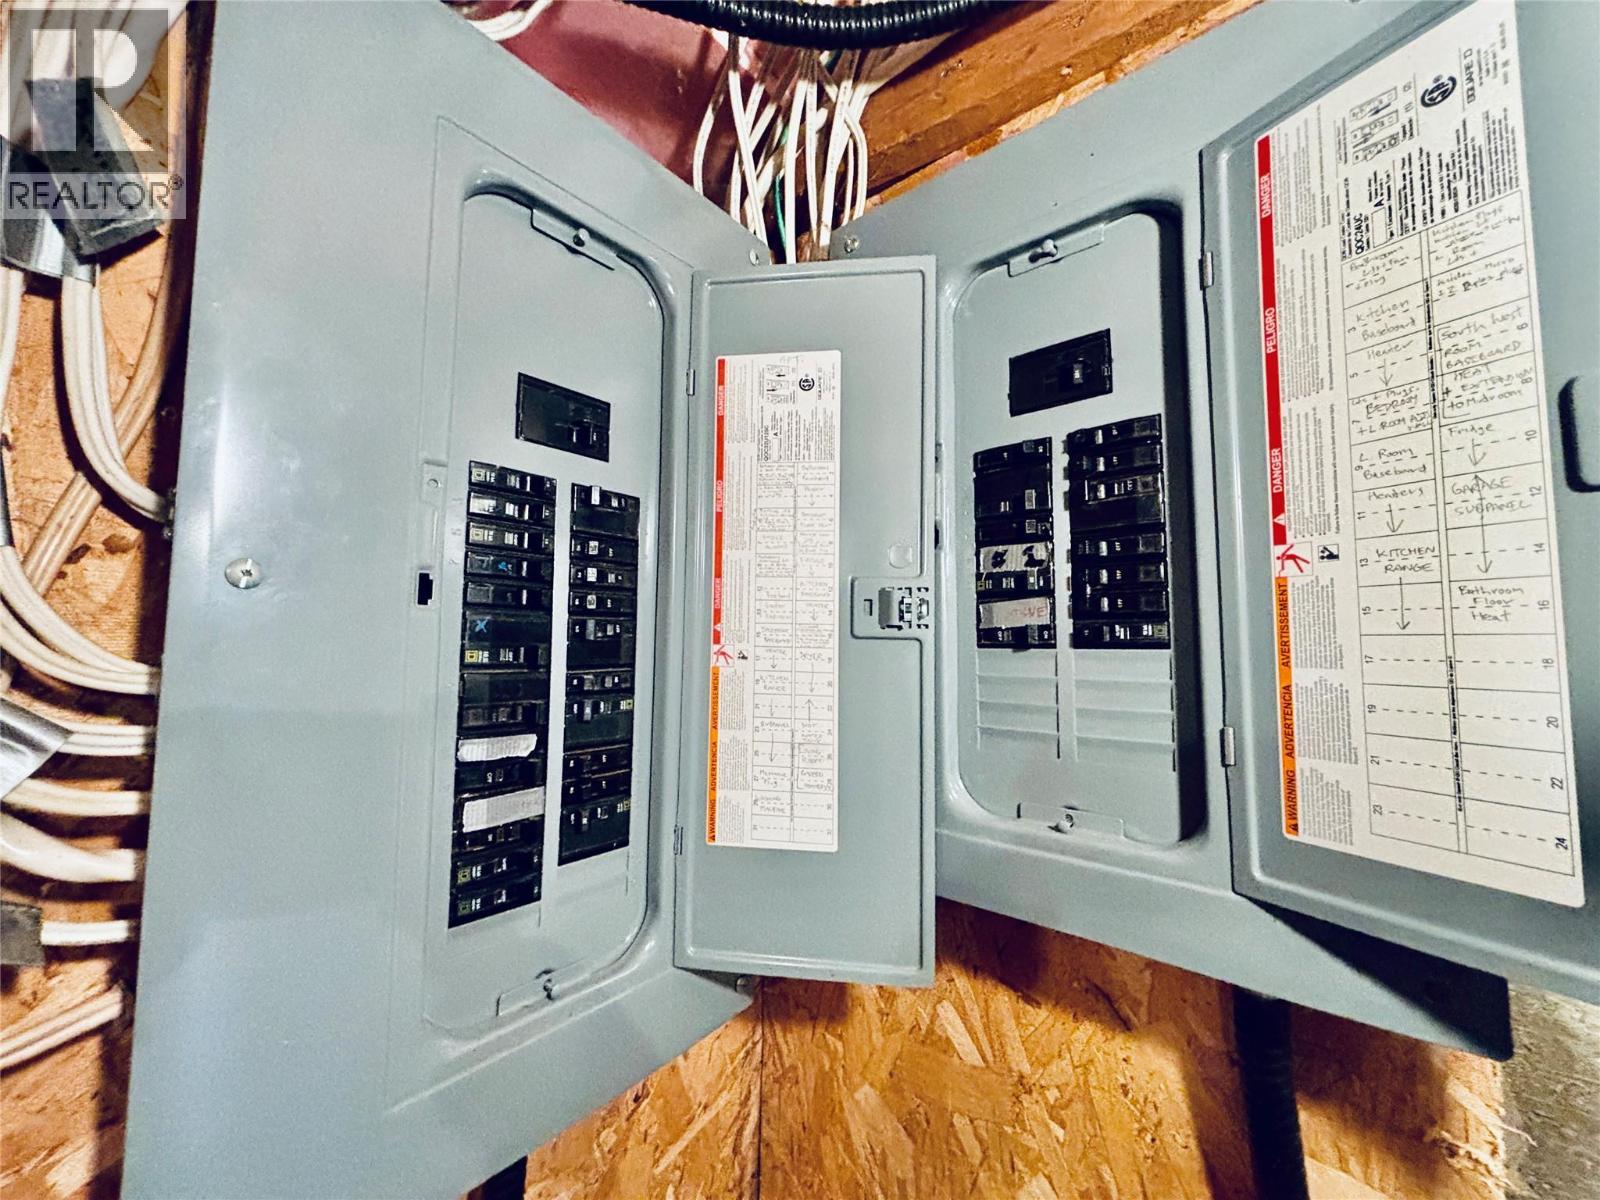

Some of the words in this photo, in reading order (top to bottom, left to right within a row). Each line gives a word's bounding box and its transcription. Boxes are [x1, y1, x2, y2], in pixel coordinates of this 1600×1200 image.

[1260, 172, 1272, 219] DANGER
[1374, 198, 1384, 208] A
[1353, 213, 1365, 255] QOC24UC
[1264, 307, 1277, 354] PELIGRO
[1447, 423, 1495, 437] Fridge
[1524, 429, 1537, 441] 10
[1272, 447, 1284, 493] DANGER
[1452, 475, 1512, 495] GARAGE
[1529, 485, 1542, 496] 12
[1454, 500, 1531, 517] SUBPANEL
[1357, 511, 1366, 520] 11
[1376, 546, 1436, 558] KITCHEN
[1533, 542, 1545, 553] 14
[1359, 558, 1368, 567] 13
[1385, 563, 1434, 573] RANGE
[1458, 585, 1524, 596] Bathroom
[1473, 597, 1515, 605] Floor
[1537, 599, 1550, 610] 16
[1362, 606, 1371, 615] 15
[1472, 610, 1511, 621] Heat
[1278, 583, 1291, 668] AVERTISSEMENT
[1365, 655, 1373, 664] 17
[1542, 657, 1554, 669] 18
[1368, 704, 1377, 714] 19
[1282, 684, 1295, 759] ADVERTENCIA
[1547, 716, 1559, 728] 20
[1370, 755, 1380, 765] 21
[1551, 776, 1564, 790] 22
[1286, 769, 1297, 821] WARNING
[1373, 805, 1383, 815] 23
[1556, 837, 1568, 850] 24
